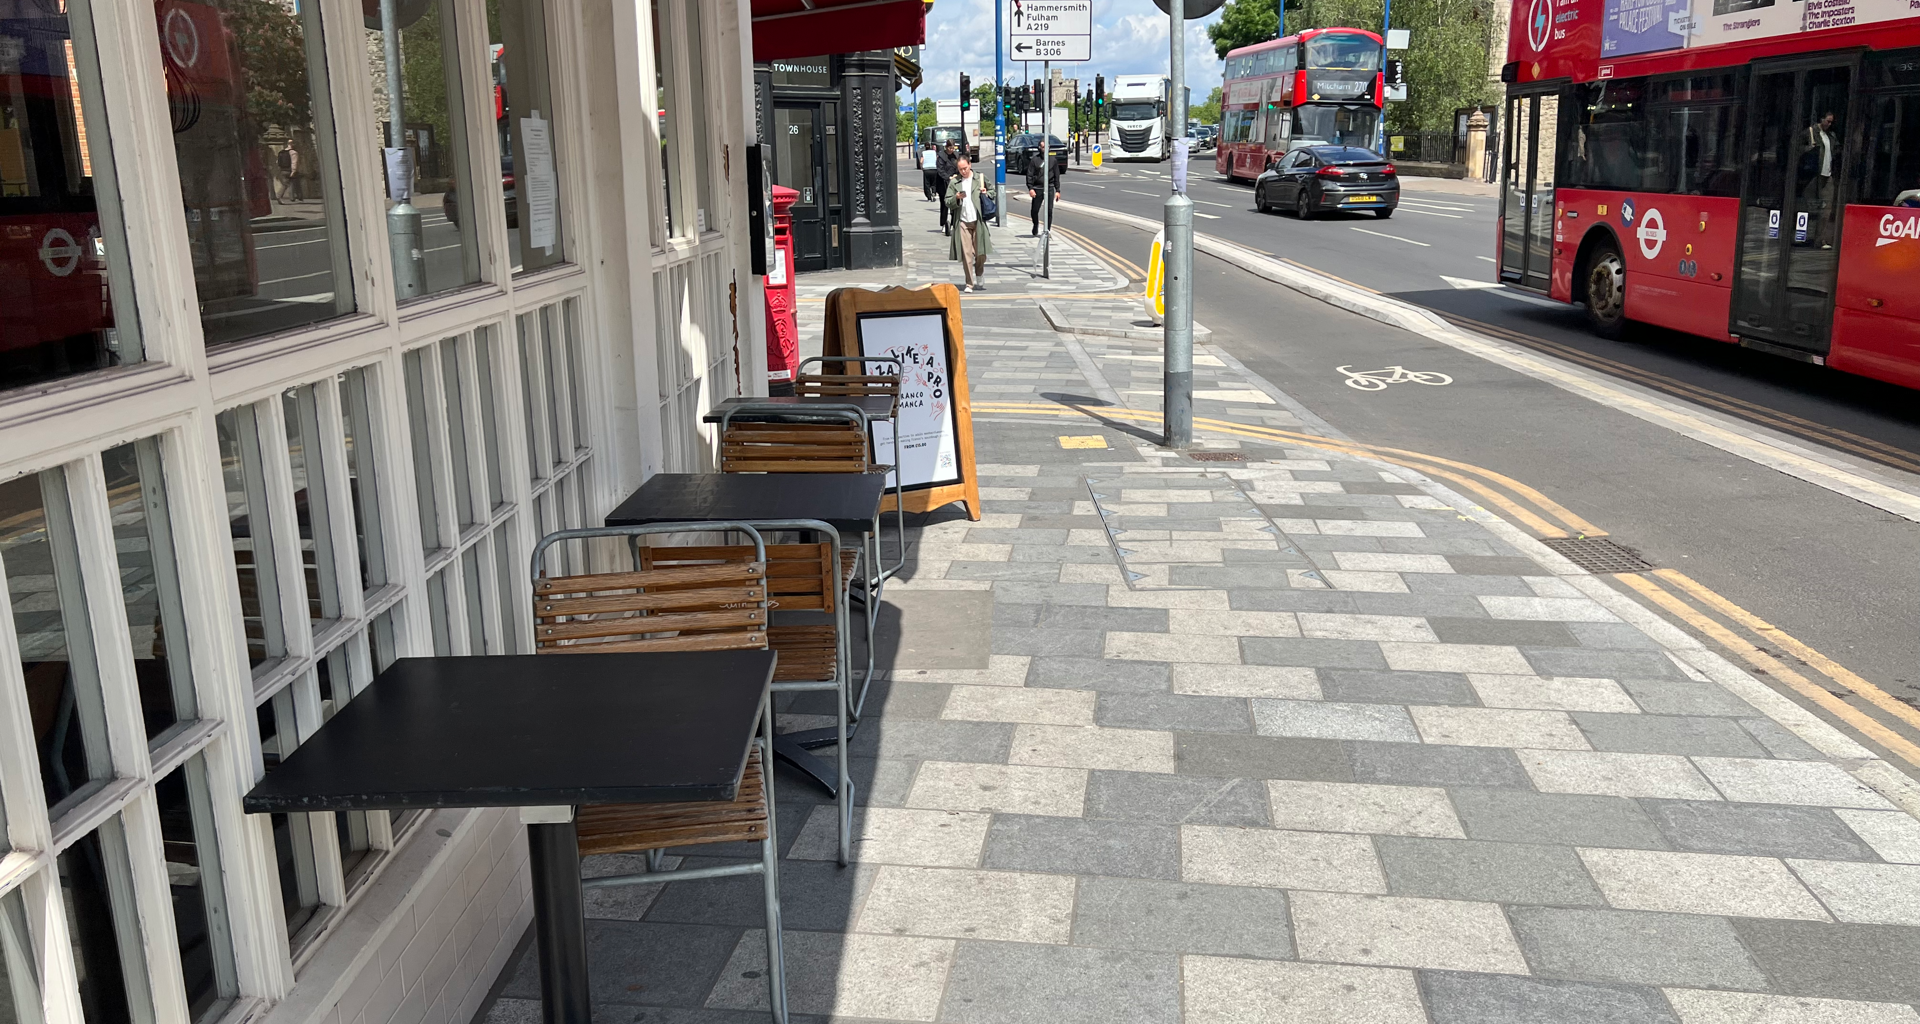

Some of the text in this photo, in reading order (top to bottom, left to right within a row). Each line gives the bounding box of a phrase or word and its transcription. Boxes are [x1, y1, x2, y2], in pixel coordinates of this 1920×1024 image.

[1026, 4, 1088, 12] Hammersmith
[1808, 1, 1822, 10] Elvis
[1909, 0, 1920, 9] Pa
[1026, 13, 1059, 21] Fulham
[1556, 8, 1579, 23] electric
[1808, 6, 1855, 20] The Imposters
[1722, 19, 1760, 31] The Stranglers
[1808, 16, 1856, 30] Charlie Sexton
[1554, 28, 1566, 40] bus
[1035, 38, 1066, 46] Barnes
[773, 63, 828, 74] TOWNHOUSE
[1316, 81, 1368, 92] Mitcham 270
[788, 125, 799, 135] 26
[890, 345, 934, 368] LIKE A
[927, 371, 943, 399] PRO
[900, 391, 924, 399] RANCO
